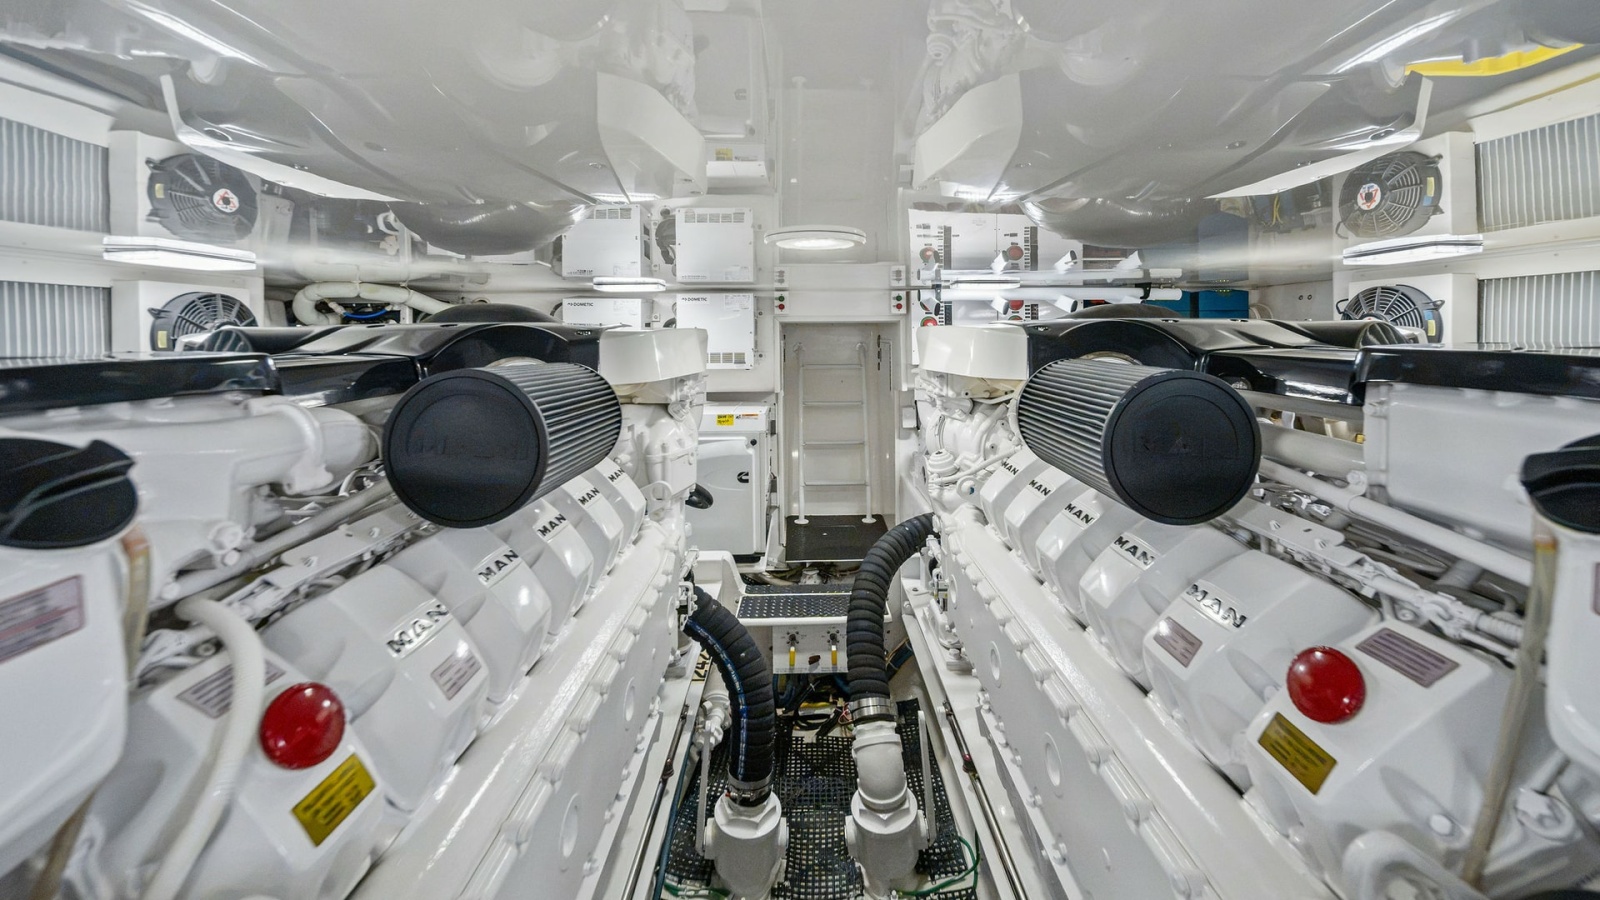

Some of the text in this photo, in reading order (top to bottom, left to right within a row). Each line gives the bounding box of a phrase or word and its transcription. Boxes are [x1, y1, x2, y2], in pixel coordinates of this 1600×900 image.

[607, 467, 625, 483] MAN
[1001, 460, 1019, 476] MAN
[578, 487, 600, 506] MAN
[1028, 479, 1051, 497] MAN
[537, 513, 567, 537] MAN
[1064, 502, 1095, 525] MAN
[1113, 535, 1156, 566] MAN
[478, 549, 519, 583] MAN
[1185, 583, 1247, 629] MAN
[386, 603, 450, 654] MAN
